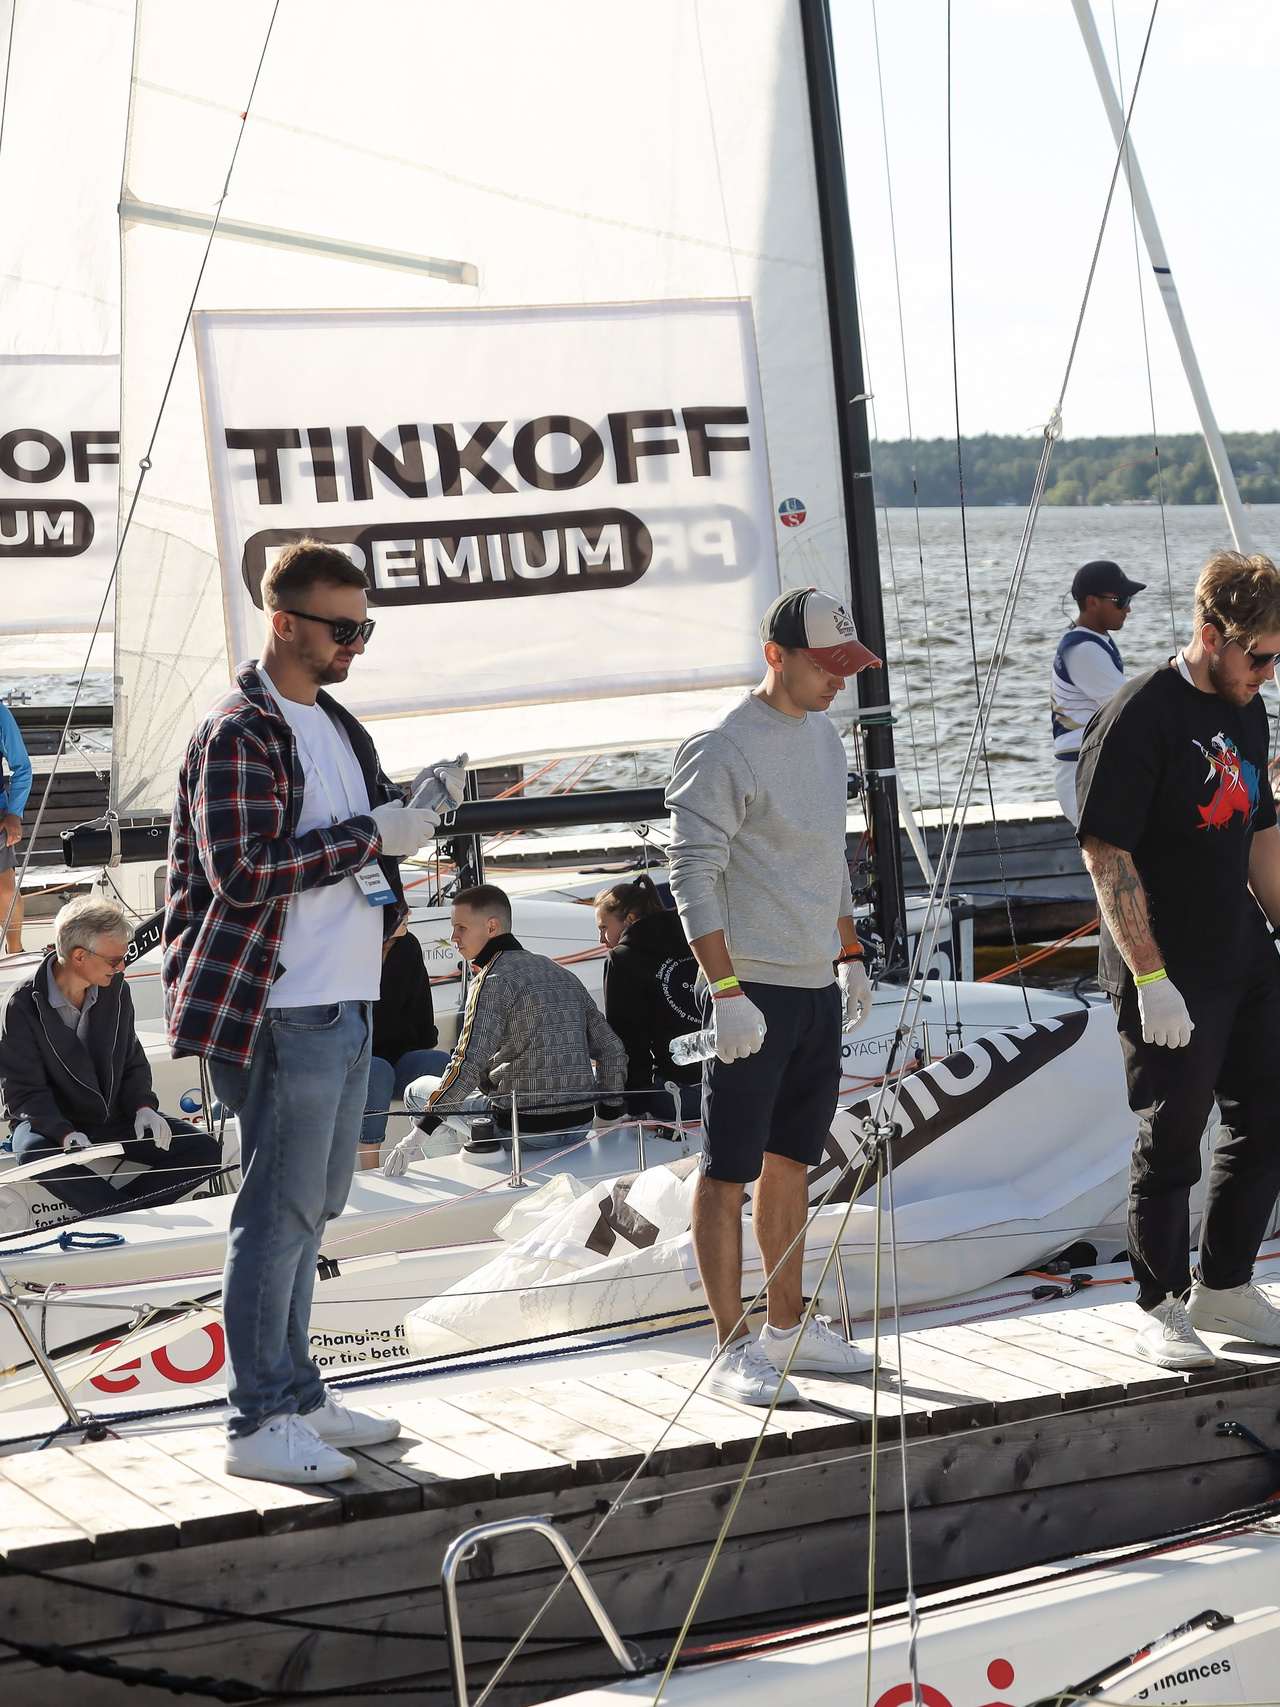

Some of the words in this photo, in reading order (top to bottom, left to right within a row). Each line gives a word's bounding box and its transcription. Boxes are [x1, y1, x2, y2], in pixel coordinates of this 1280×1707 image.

[225, 406, 751, 505] TINKOFF
[264, 522, 628, 590] EMIUM
[124, 926, 160, 961] g.ru
[310, 1329, 390, 1346] Changing
[312, 1354, 336, 1366] for
